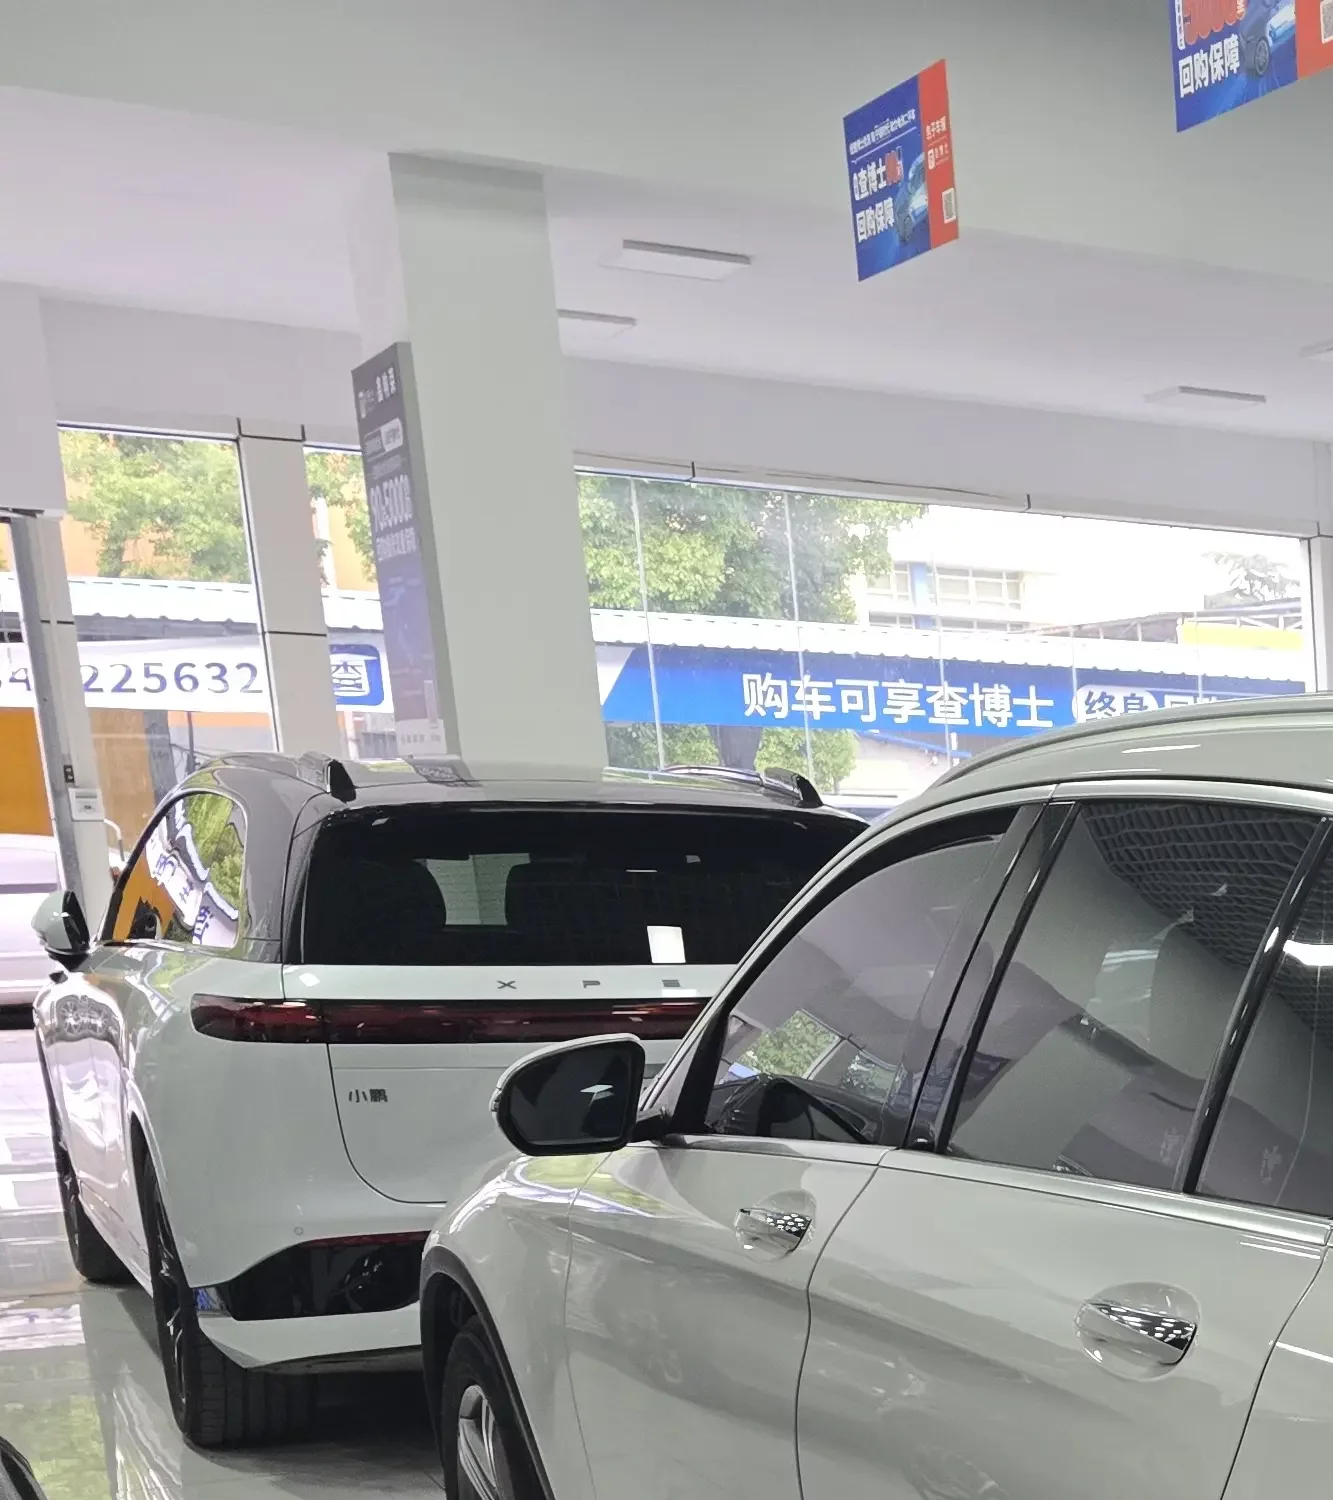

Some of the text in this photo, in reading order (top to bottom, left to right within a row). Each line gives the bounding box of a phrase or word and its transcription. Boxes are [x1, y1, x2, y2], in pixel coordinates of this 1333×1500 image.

[1178, 34, 1240, 98] 回购保障
[856, 197, 895, 243] 回购保障
[741, 671, 1056, 730] 购车可享查博士
[348, 1089, 389, 1103] 小鹏
